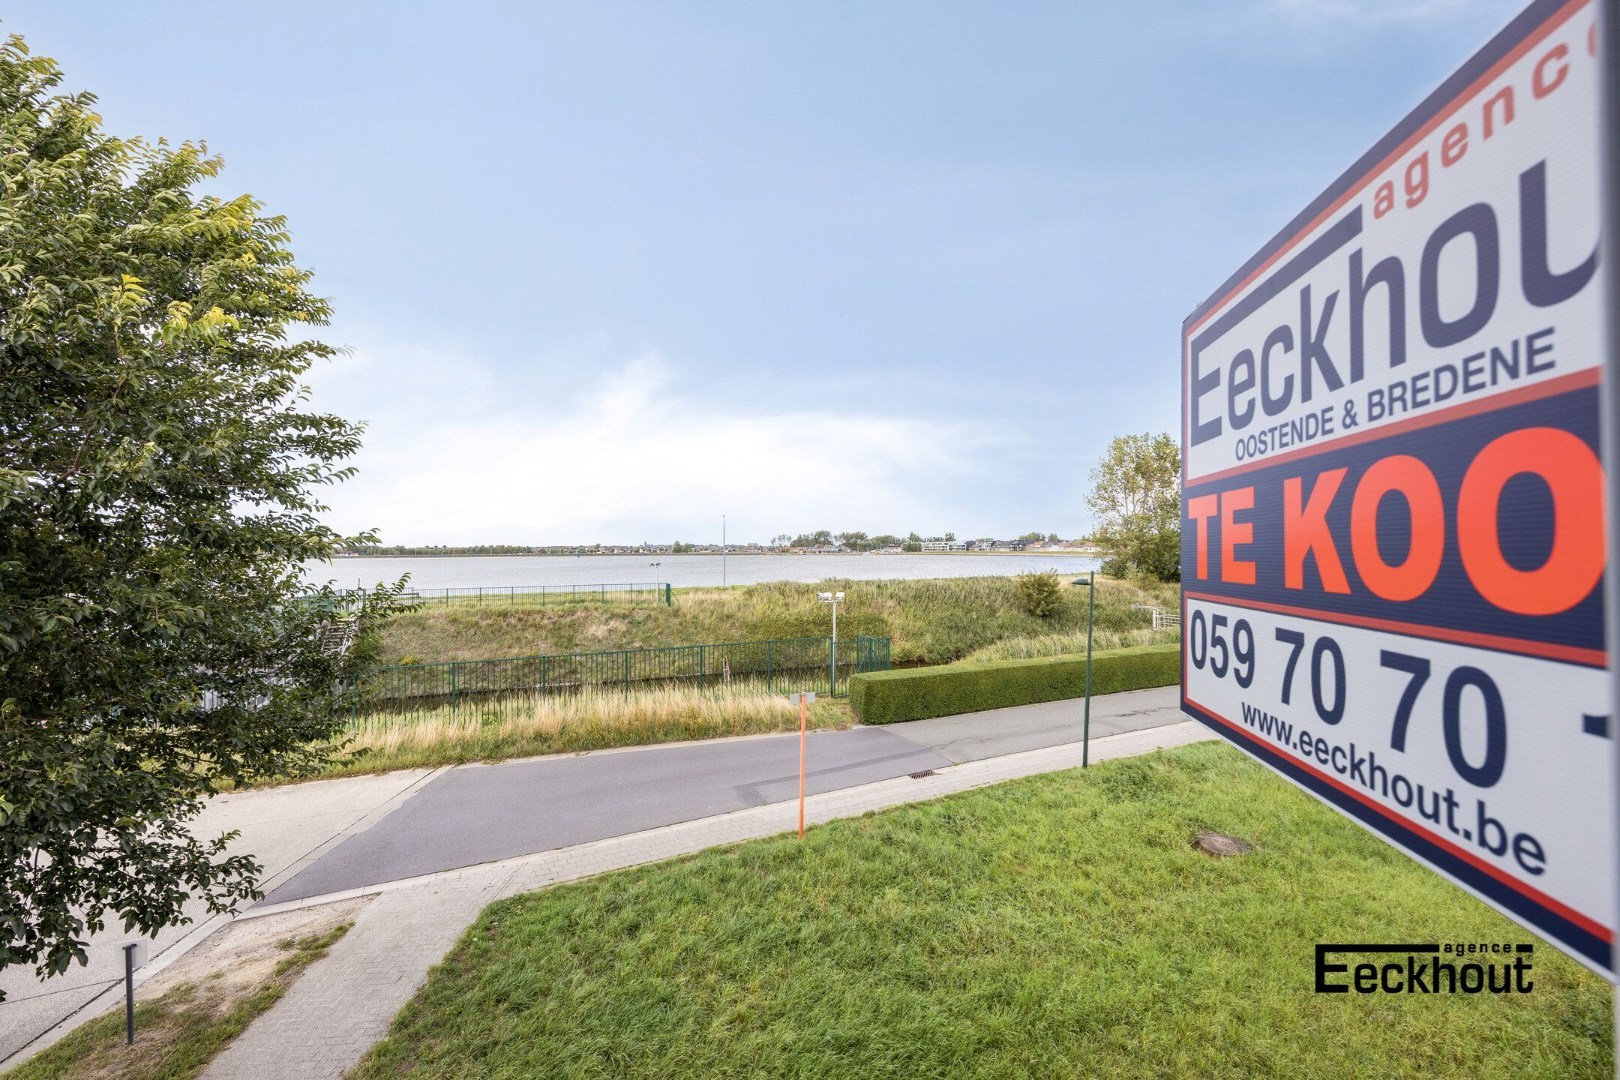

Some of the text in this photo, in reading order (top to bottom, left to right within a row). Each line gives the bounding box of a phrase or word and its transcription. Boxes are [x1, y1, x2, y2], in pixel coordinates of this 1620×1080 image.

[1235, 326, 1557, 462] OOSTENDE & BREDENE
[1188, 426, 1608, 616] TE KOO
[1190, 609, 1508, 789] 059 70 70
[1241, 701, 1547, 877] www.eeckhout.be
